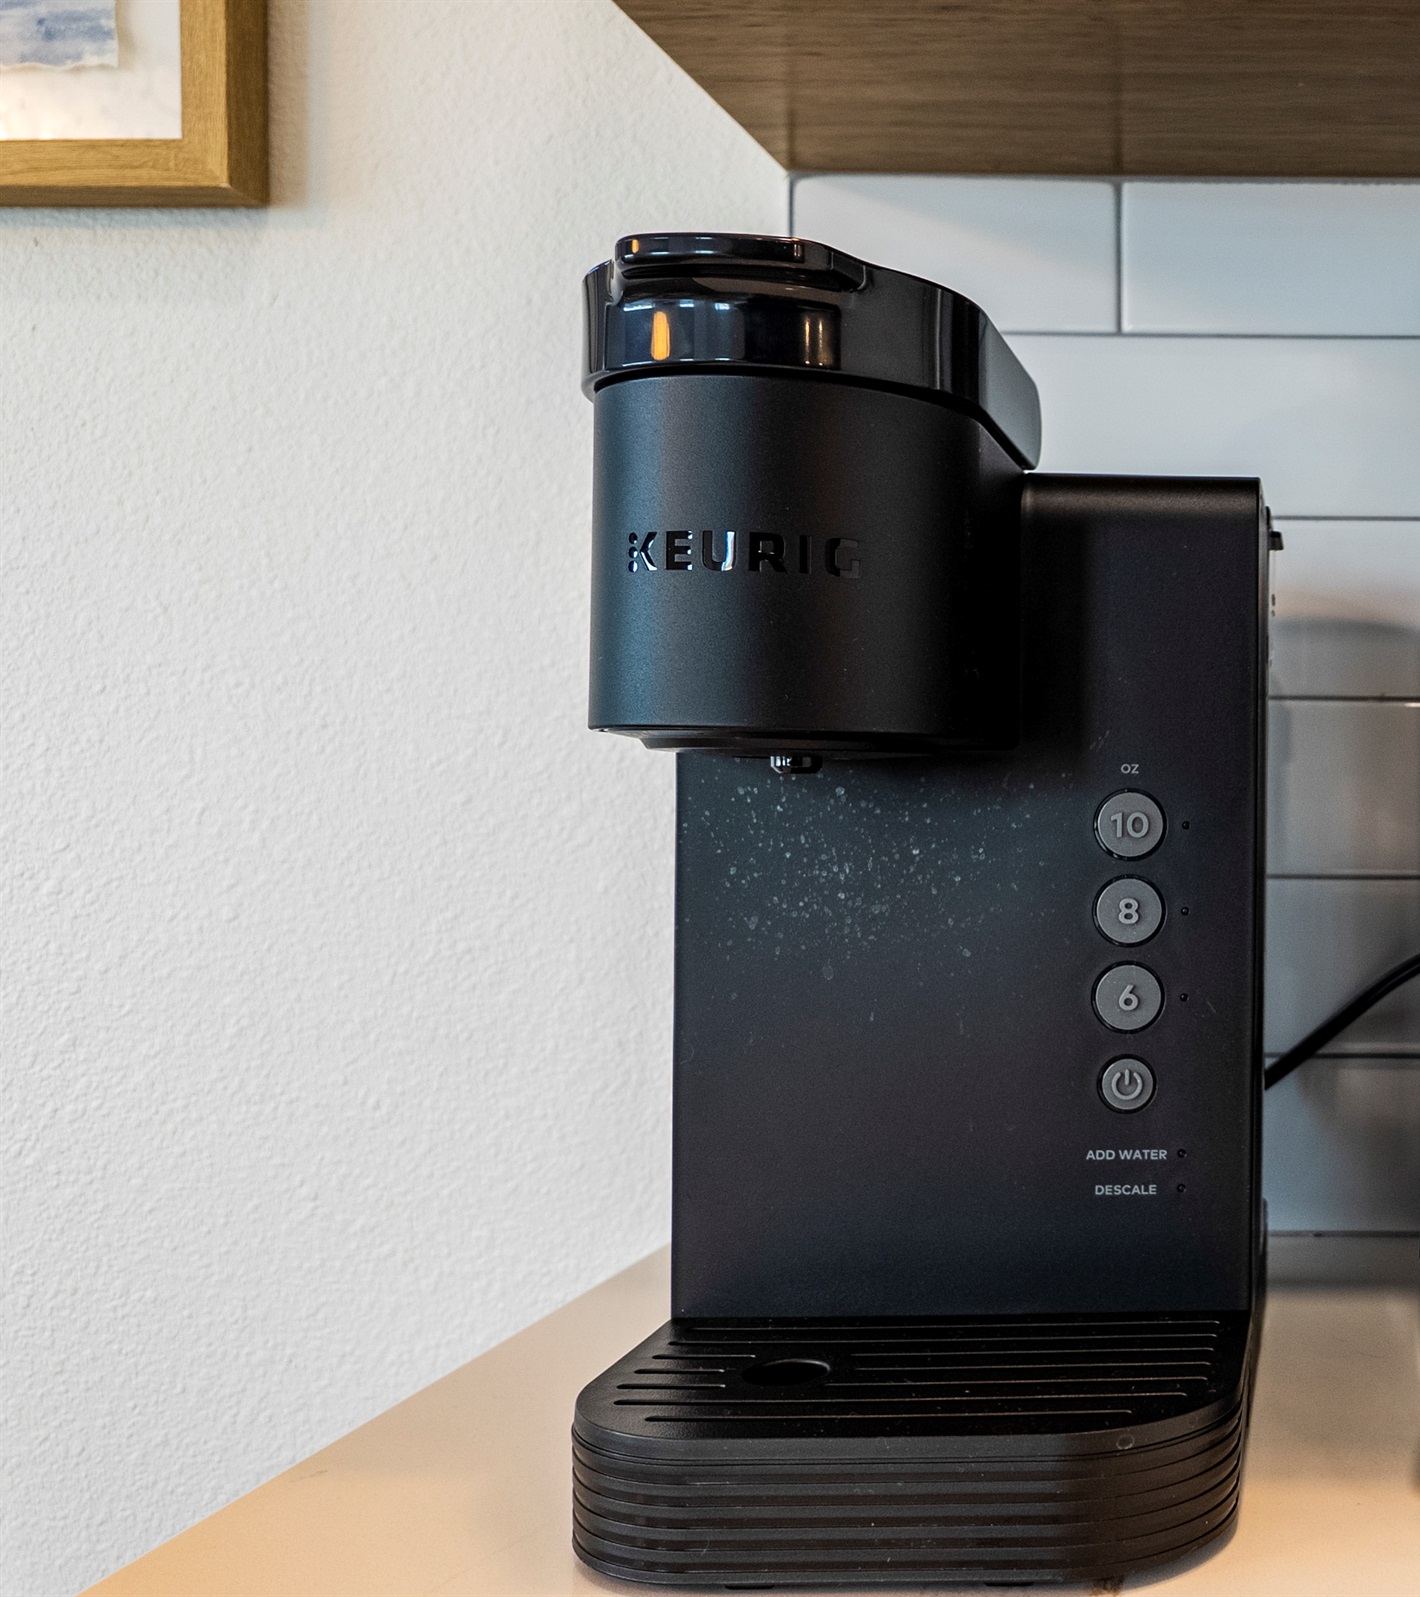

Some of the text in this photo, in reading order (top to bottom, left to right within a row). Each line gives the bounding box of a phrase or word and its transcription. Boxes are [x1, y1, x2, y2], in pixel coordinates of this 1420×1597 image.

[628, 530, 860, 579] KEURIG
[1120, 764, 1140, 775] OZ
[1110, 811, 1150, 839] 10
[1117, 897, 1140, 924] 8
[1118, 984, 1139, 1011] 6
[1086, 1149, 1168, 1160] ADD WATER
[1094, 1184, 1158, 1196] DESCALE
